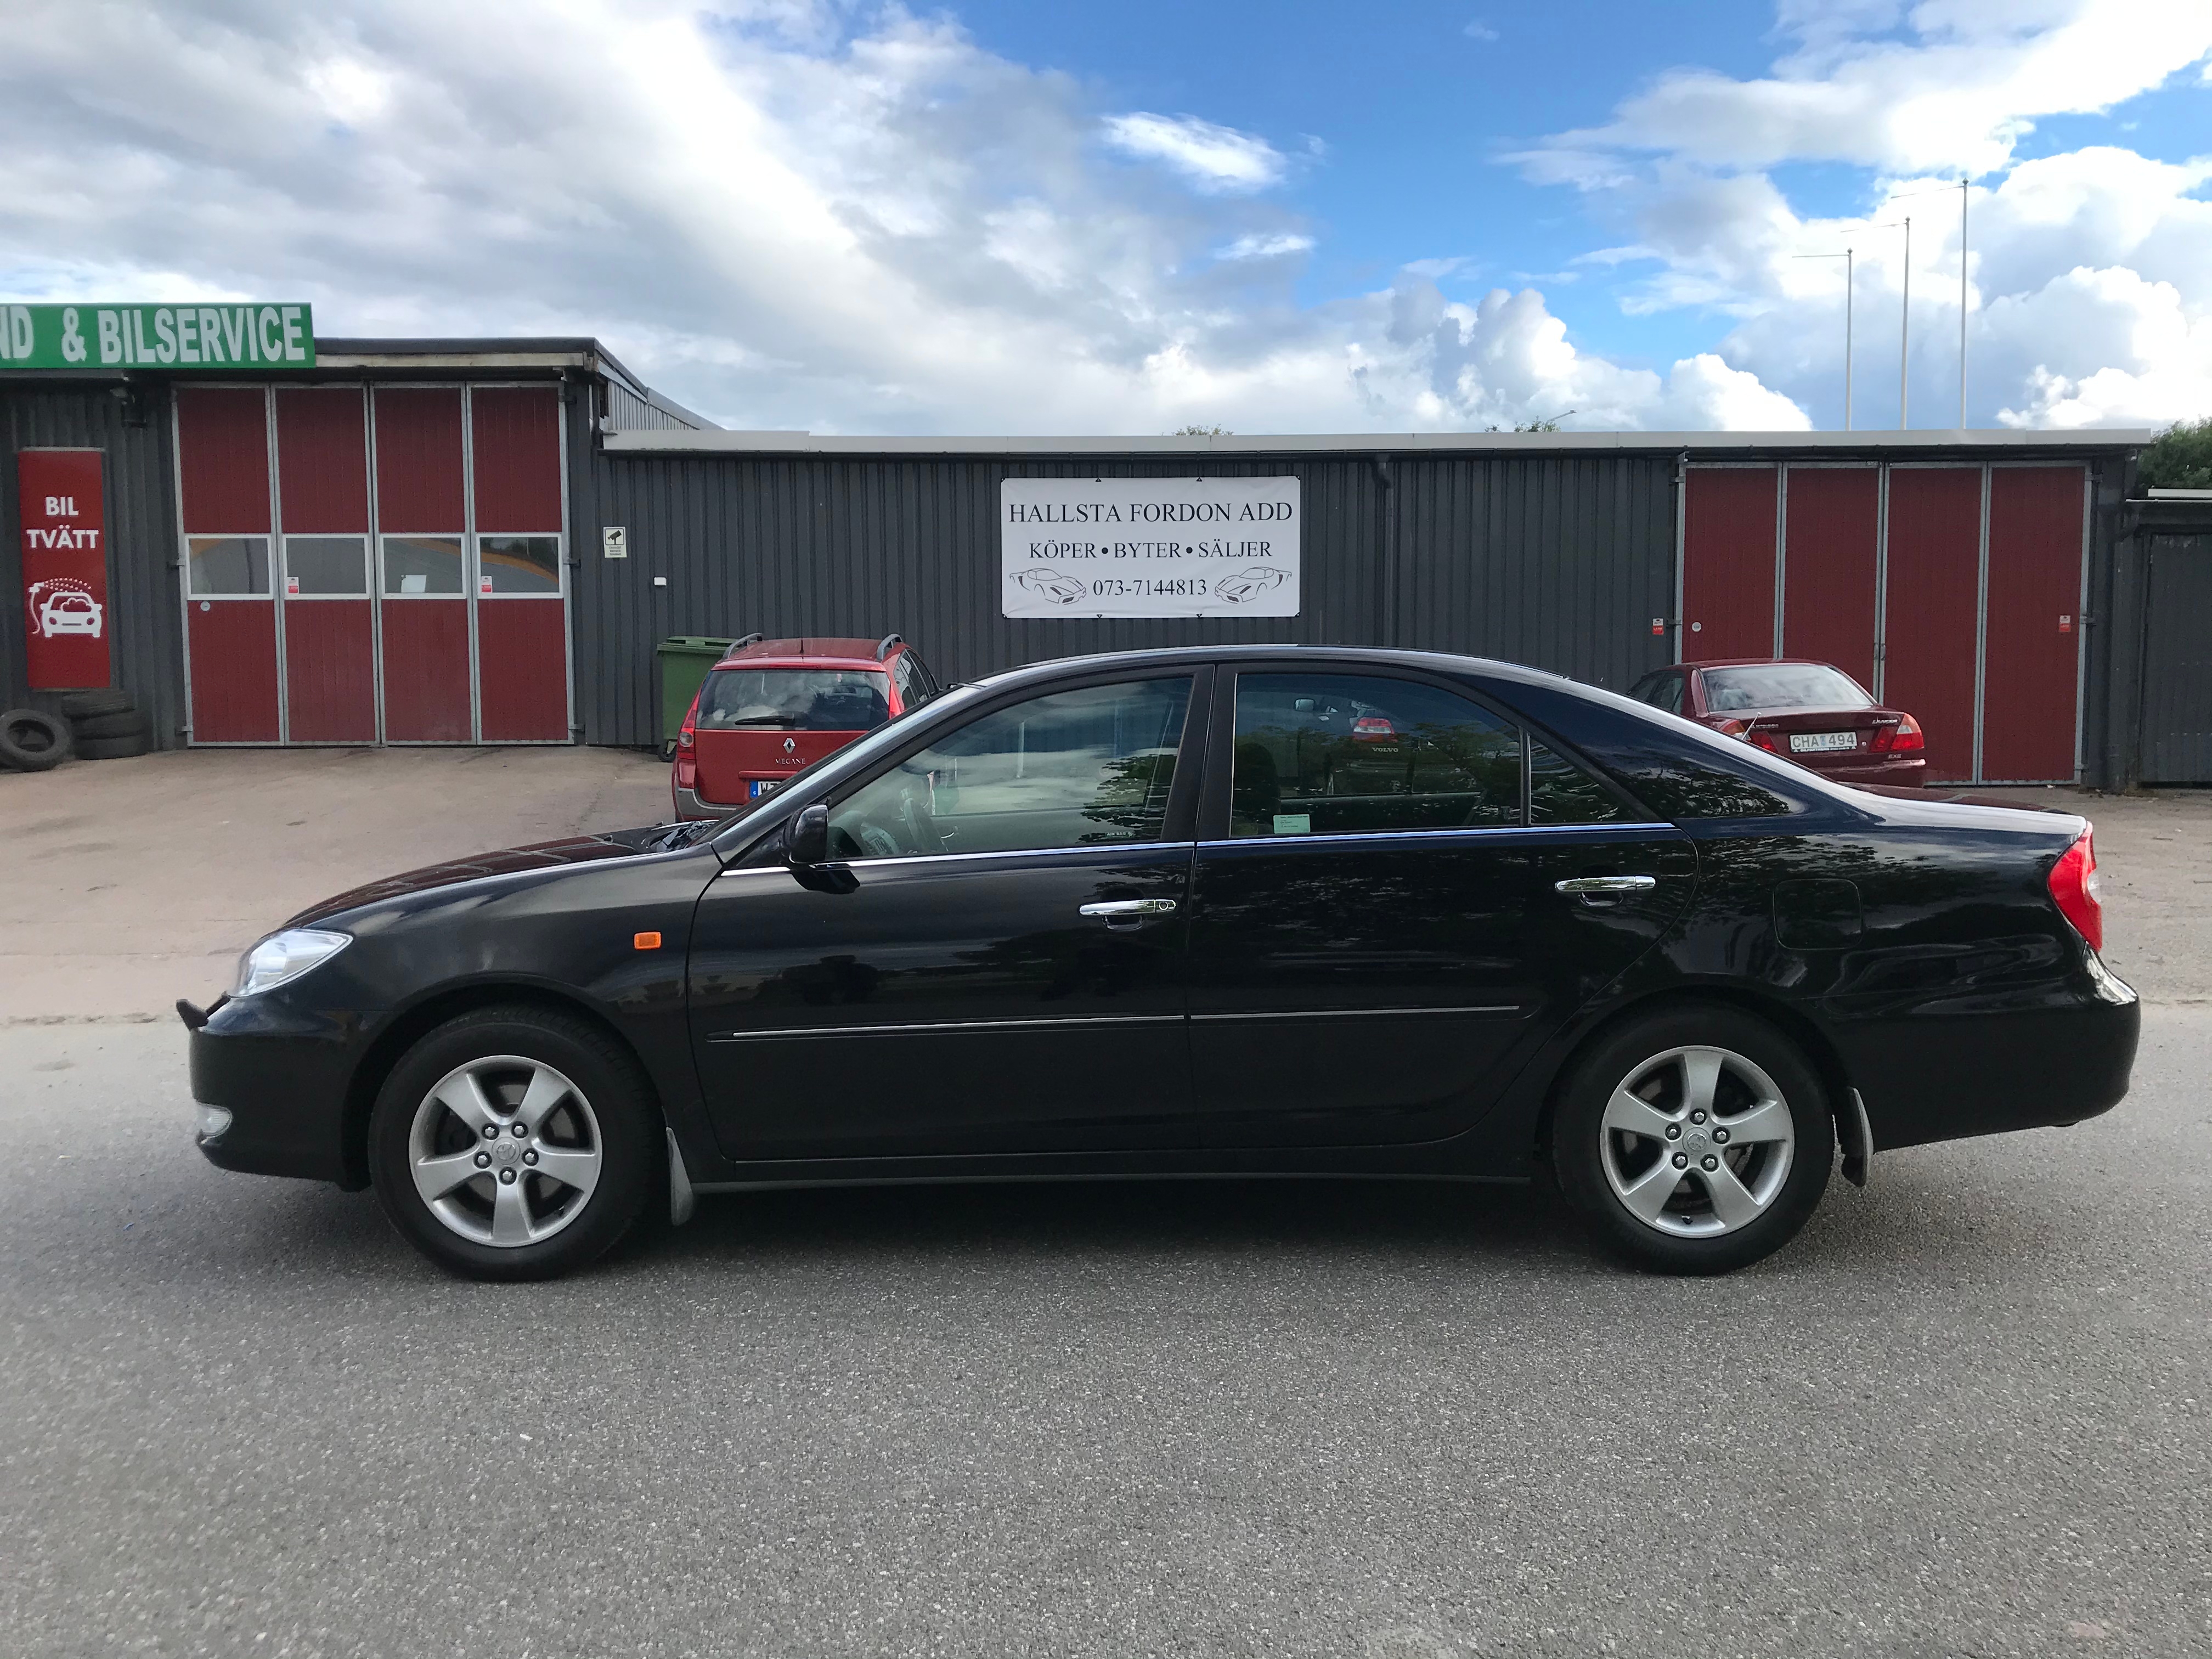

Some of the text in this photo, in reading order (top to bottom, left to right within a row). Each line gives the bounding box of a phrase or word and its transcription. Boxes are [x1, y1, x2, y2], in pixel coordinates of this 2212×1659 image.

[61, 307, 87, 362] &
[98, 306, 306, 364] BILSERVICE
[46, 496, 79, 516] BIL
[1009, 502, 1293, 522] HALLSTA FORDON ADD
[26, 524, 99, 549] TVÄTT
[1029, 539, 1273, 558] KÖPER BYTER SÄLJER
[1093, 579, 1207, 596] 073-7144813
[1792, 733, 1855, 748] CHA 494
